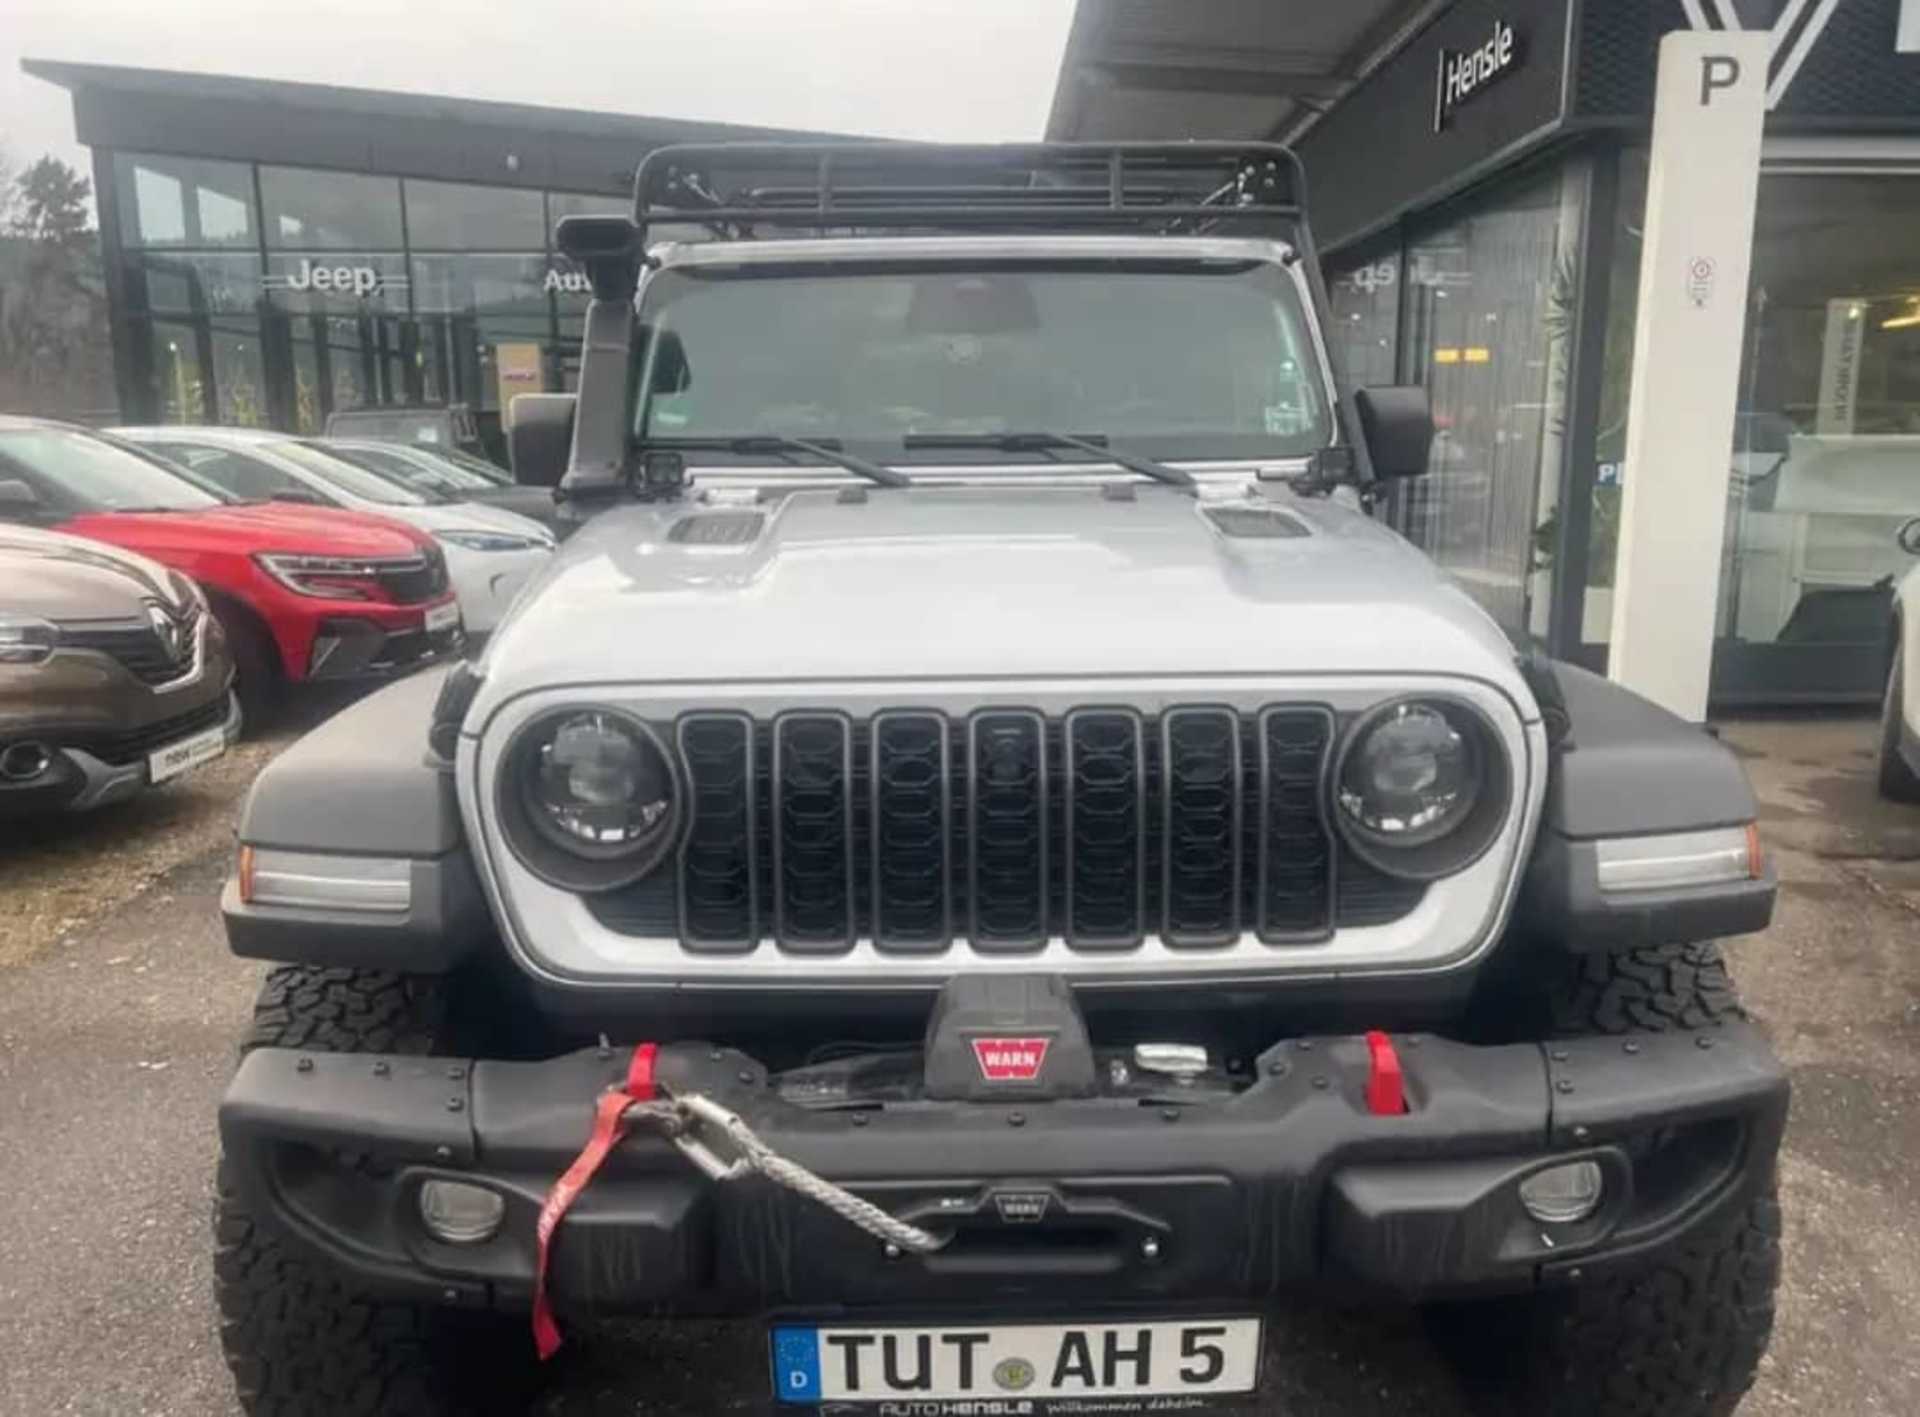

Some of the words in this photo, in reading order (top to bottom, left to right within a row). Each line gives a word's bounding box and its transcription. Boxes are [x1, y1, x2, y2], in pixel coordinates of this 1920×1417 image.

[1447, 21, 1512, 104] Hensle
[1701, 56, 1740, 106] P
[287, 259, 376, 295] Jeep
[985, 1052, 1035, 1067] WARN
[790, 1370, 807, 1388] D
[827, 1334, 989, 1390] TUT
[1051, 1329, 1152, 1388] AH
[1180, 1327, 1226, 1383] 5
